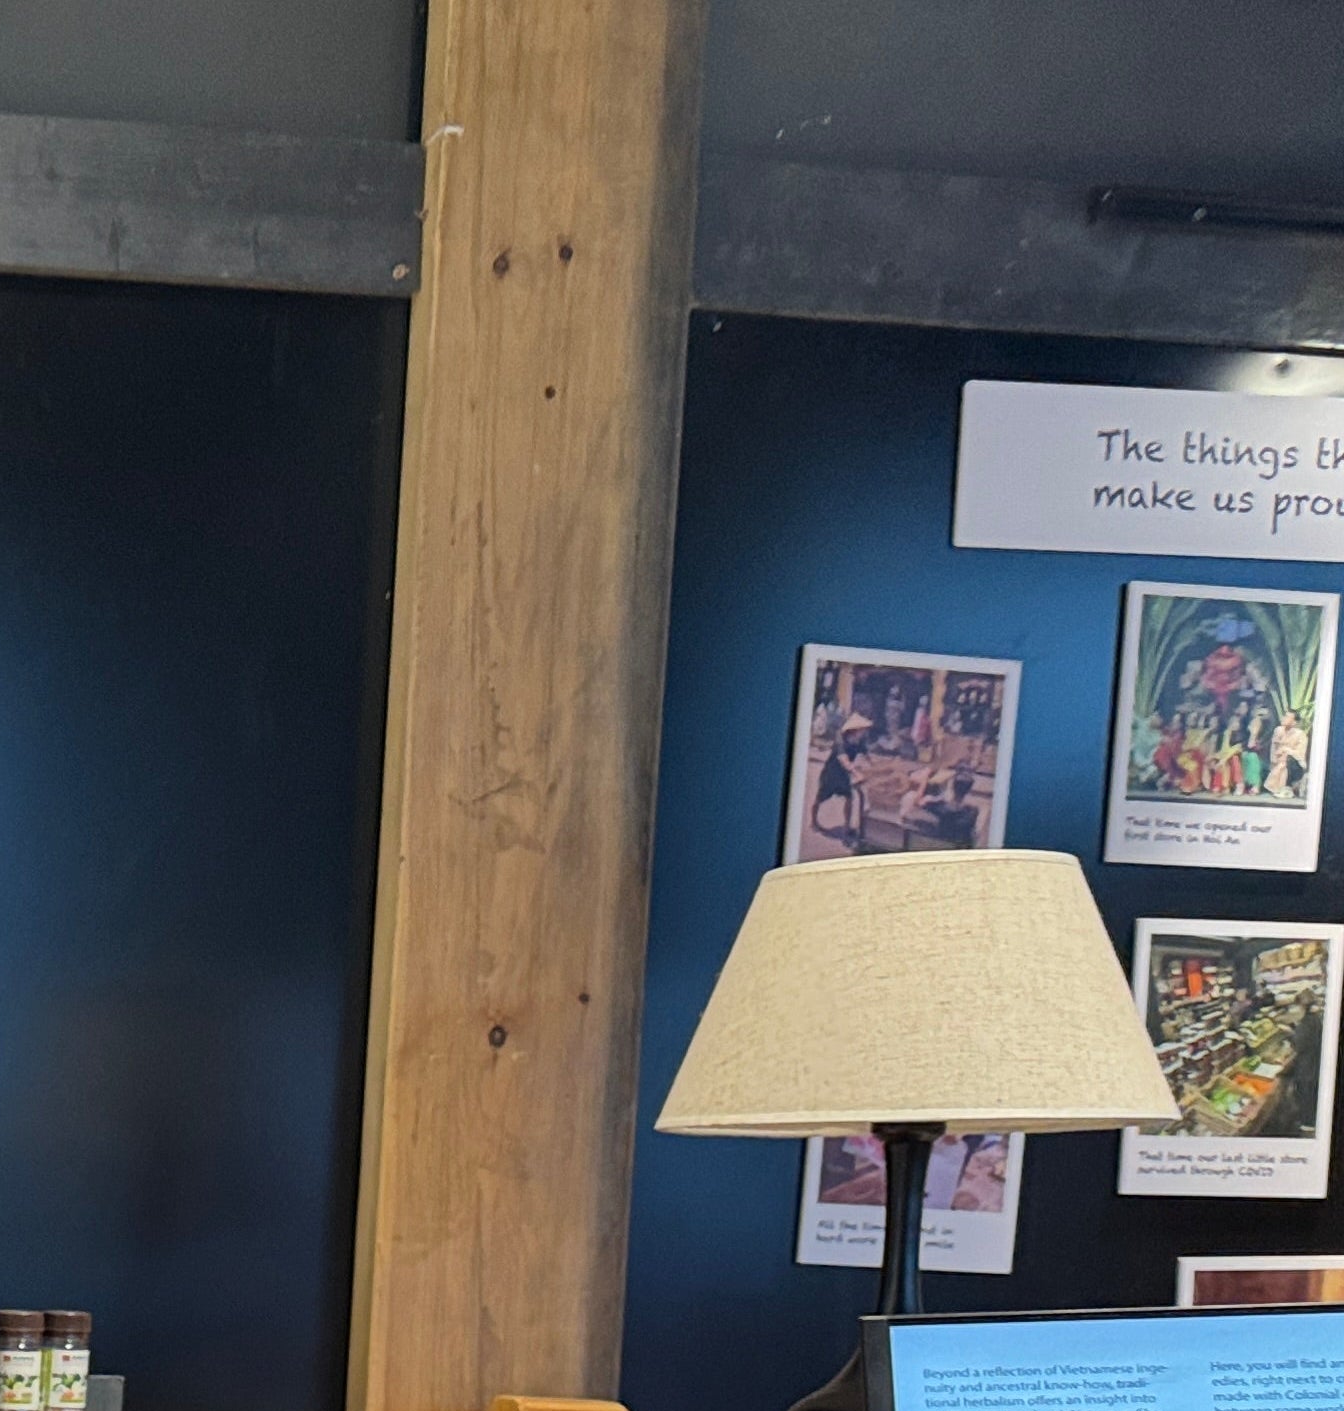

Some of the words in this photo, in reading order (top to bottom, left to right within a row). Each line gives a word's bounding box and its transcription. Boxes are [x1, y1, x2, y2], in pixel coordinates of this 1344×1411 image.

[1098, 429, 1165, 464] The
[1183, 431, 1300, 480] things
[1093, 481, 1196, 511] make
[1214, 488, 1254, 513] us
[923, 1368, 969, 1379] Beyond
[983, 1366, 1042, 1377] reflection
[1045, 1365, 1057, 1375] of
[1057, 1364, 1133, 1375] Vietnamese
[924, 1383, 955, 1394] nuity
[959, 1382, 982, 1393] and
[986, 1380, 1041, 1391] ancestral
[926, 1397, 960, 1408] tional
[963, 1396, 1024, 1407] herbalism
[1028, 1395, 1062, 1406] offers
[1066, 1396, 1082, 1405] an
[1085, 1393, 1127, 1406] insight
[1131, 1393, 1156, 1403] into
